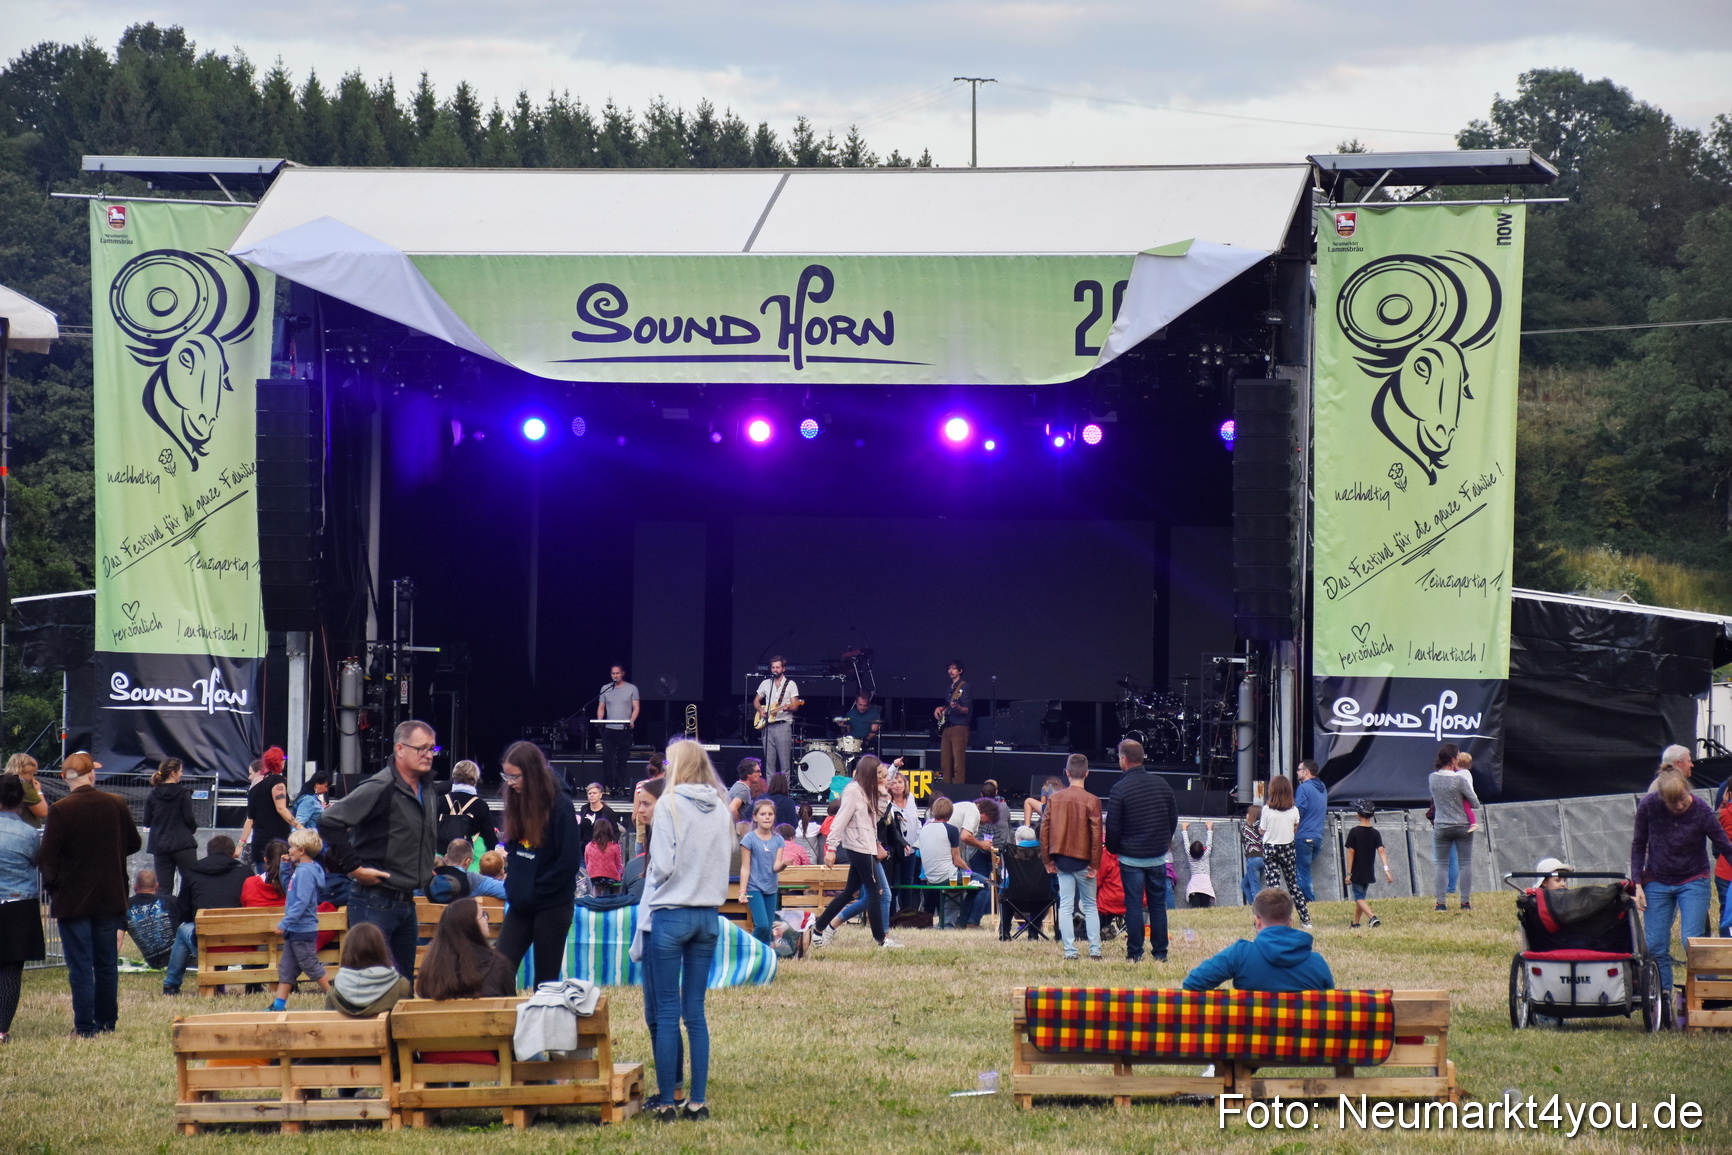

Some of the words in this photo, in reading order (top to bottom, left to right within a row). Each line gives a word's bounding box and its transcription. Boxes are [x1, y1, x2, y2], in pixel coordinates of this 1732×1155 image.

[1496, 213, 1512, 246] now
[107, 465, 161, 494] nachhaltig
[1335, 481, 1391, 511] nachhaltig
[102, 555, 122, 578] Das
[120, 525, 164, 558] Festival
[163, 515, 181, 535] für
[196, 487, 221, 517] ganze
[1323, 576, 1351, 600] Das
[1348, 543, 1394, 578] Festival
[1393, 531, 1412, 553] für
[1414, 520, 1431, 539] die
[1434, 500, 1461, 531] ganze
[112, 612, 163, 646] persönlich
[1339, 634, 1394, 669] persönlich
[1560, 976, 1591, 984] THULE
